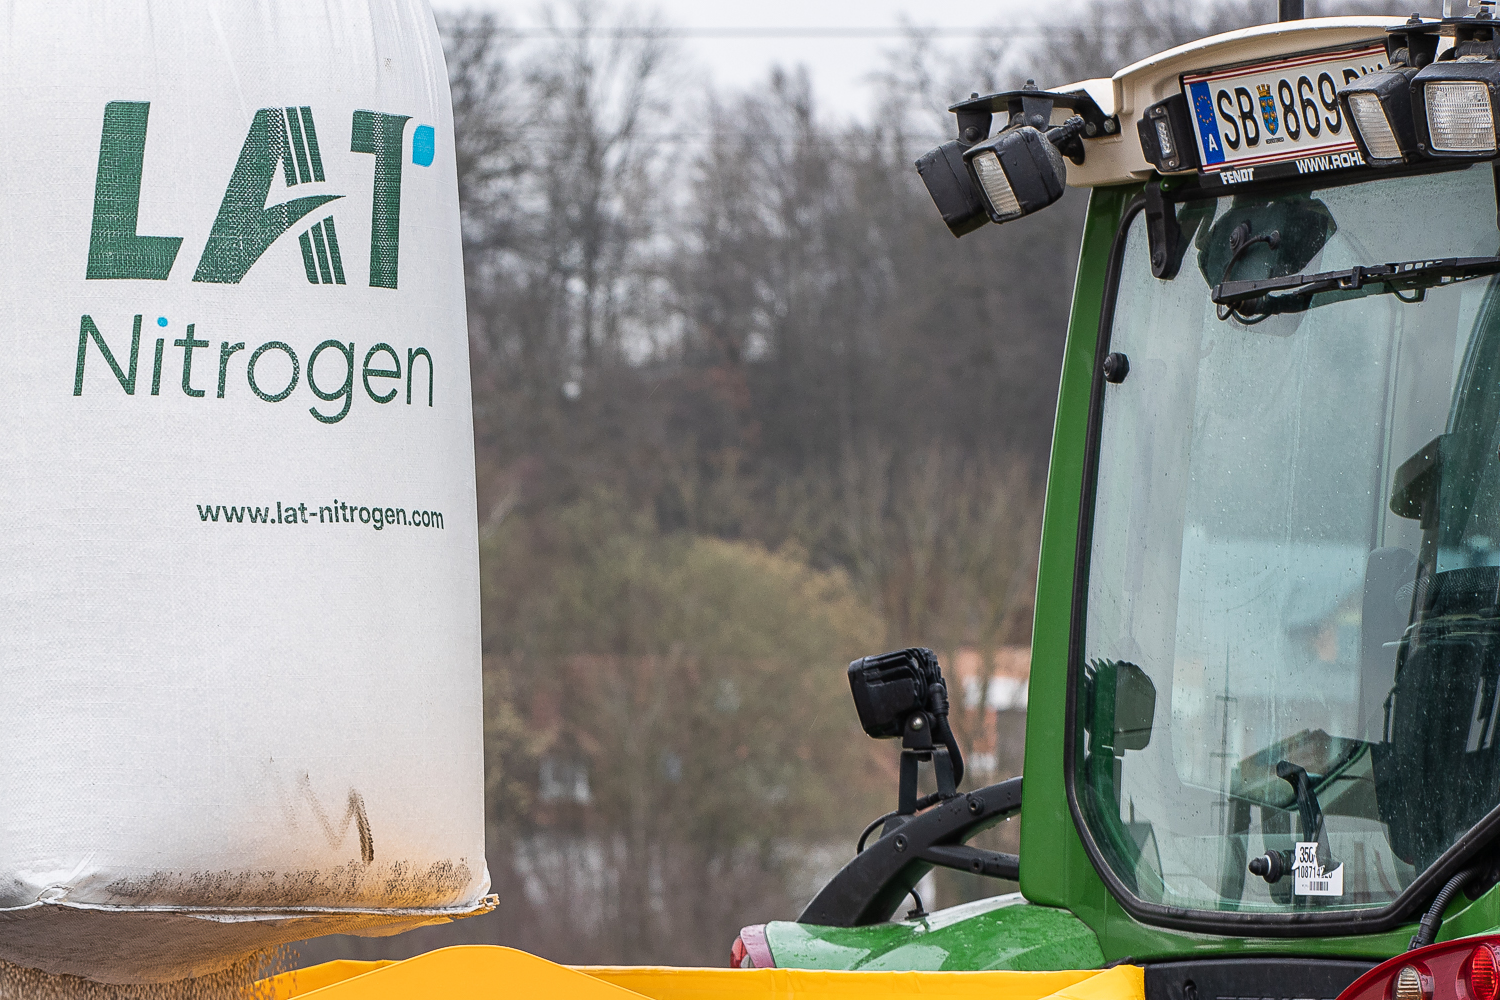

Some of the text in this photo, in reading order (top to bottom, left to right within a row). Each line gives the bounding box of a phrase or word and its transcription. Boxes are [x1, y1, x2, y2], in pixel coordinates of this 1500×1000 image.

[1208, 71, 1342, 151] A SB 869
[85, 100, 435, 290] LAT
[1219, 167, 1255, 185] FENDT
[72, 312, 434, 424] Nitrogen
[196, 499, 445, 531] www.lat-nitrogen.com
